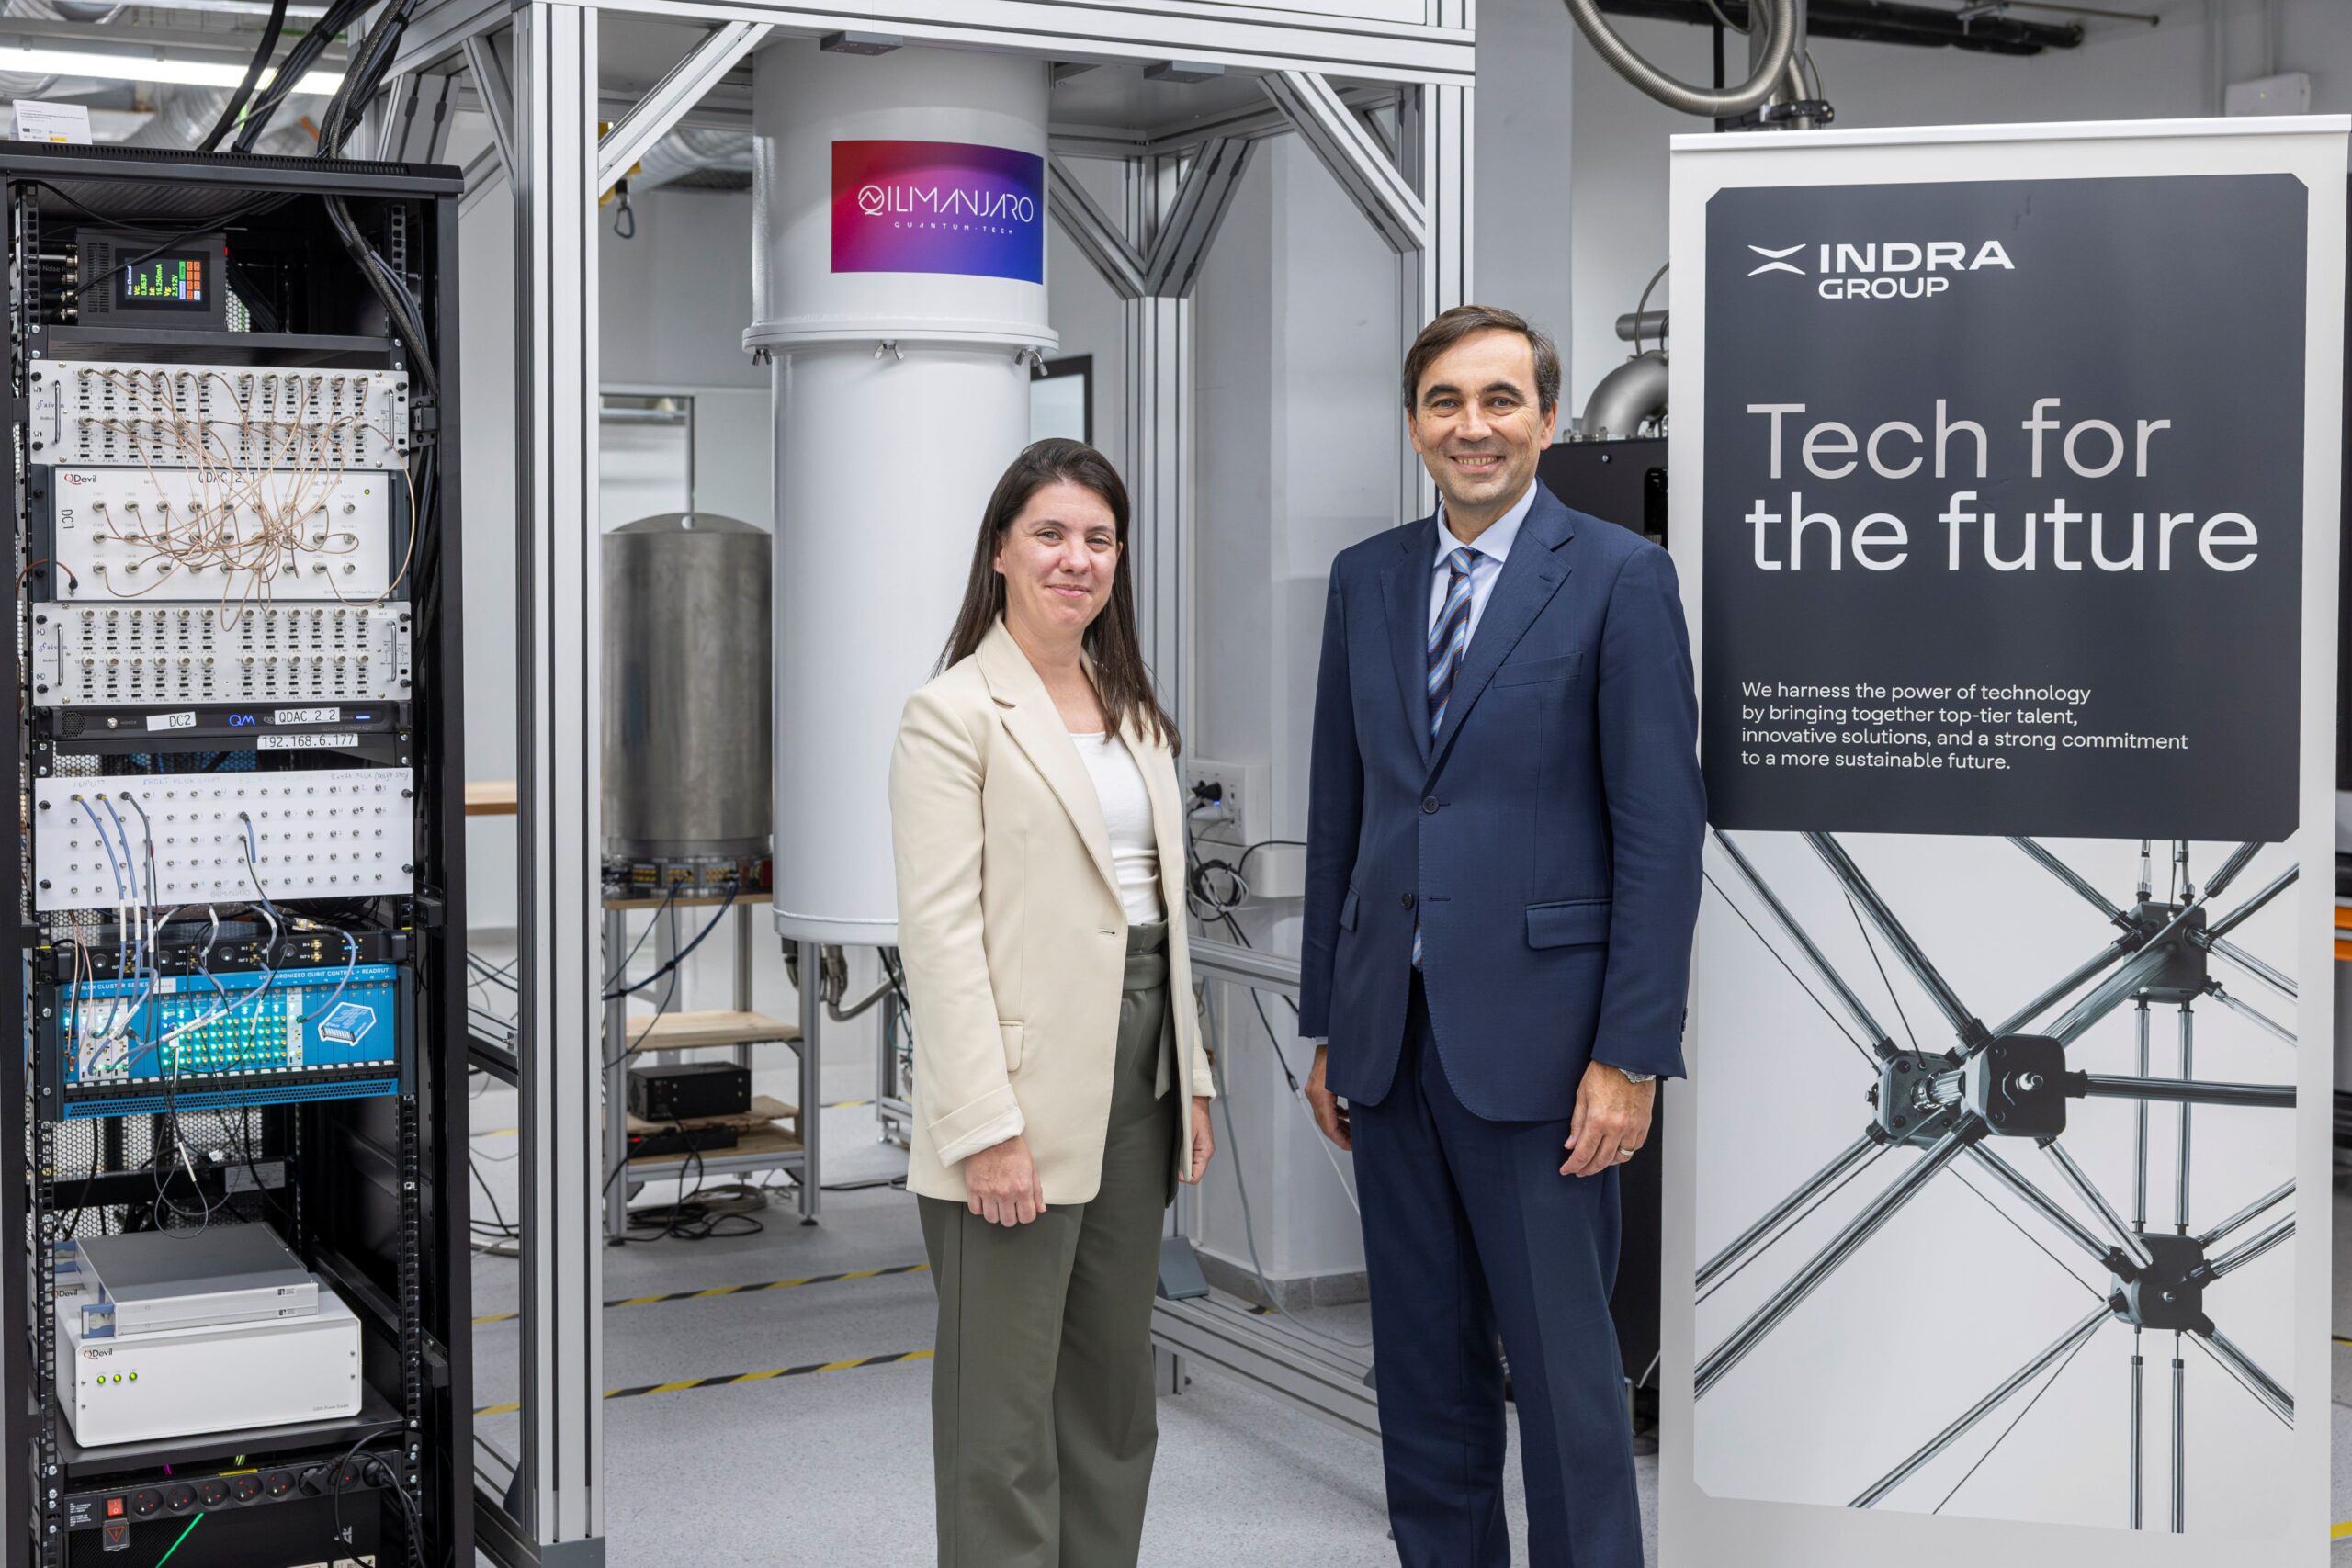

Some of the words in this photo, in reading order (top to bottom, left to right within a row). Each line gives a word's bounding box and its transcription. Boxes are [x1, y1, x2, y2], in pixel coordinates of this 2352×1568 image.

[1820, 241, 2015, 273] INDRA
[1818, 277, 1949, 299] GROUP
[35, 400, 65, 410] Saivn
[1747, 400, 1987, 479] Tech
[2022, 398, 2170, 478] for
[64, 474, 97, 485] QDevil
[61, 509, 75, 529] DC1
[1745, 492, 1907, 570] the
[1939, 491, 2257, 571] future
[39, 642, 68, 653] Saivn
[1742, 682, 1771, 696] We
[1779, 682, 1849, 698] harness
[1856, 683, 1885, 698] the
[1893, 687, 1951, 702] power
[1957, 684, 1976, 699] of
[1981, 684, 2091, 705] technology
[169, 715, 191, 727] DC2
[229, 714, 256, 726] QM
[279, 711, 307, 723] QDAC
[1743, 705, 1764, 723] by
[1770, 705, 1846, 724] bringing
[1852, 706, 1934, 725] together
[1939, 707, 2011, 726] top-tier
[2017, 708, 2077, 726] talent,
[263, 734, 354, 747] 192.168.6.177
[1743, 728, 1837, 743] innovative
[1842, 728, 1931, 747] solutions,
[1938, 730, 1972, 745] and
[1978, 735, 1988, 746] a
[1995, 732, 2055, 750] strong
[2062, 733, 2188, 749] commitment
[1742, 751, 1759, 764] to
[1766, 754, 1775, 765] a
[1782, 754, 1829, 765] more
[1836, 752, 1942, 768] sustainable
[1948, 753, 2010, 769] future.
[83, 1348, 113, 1360] QDevil
